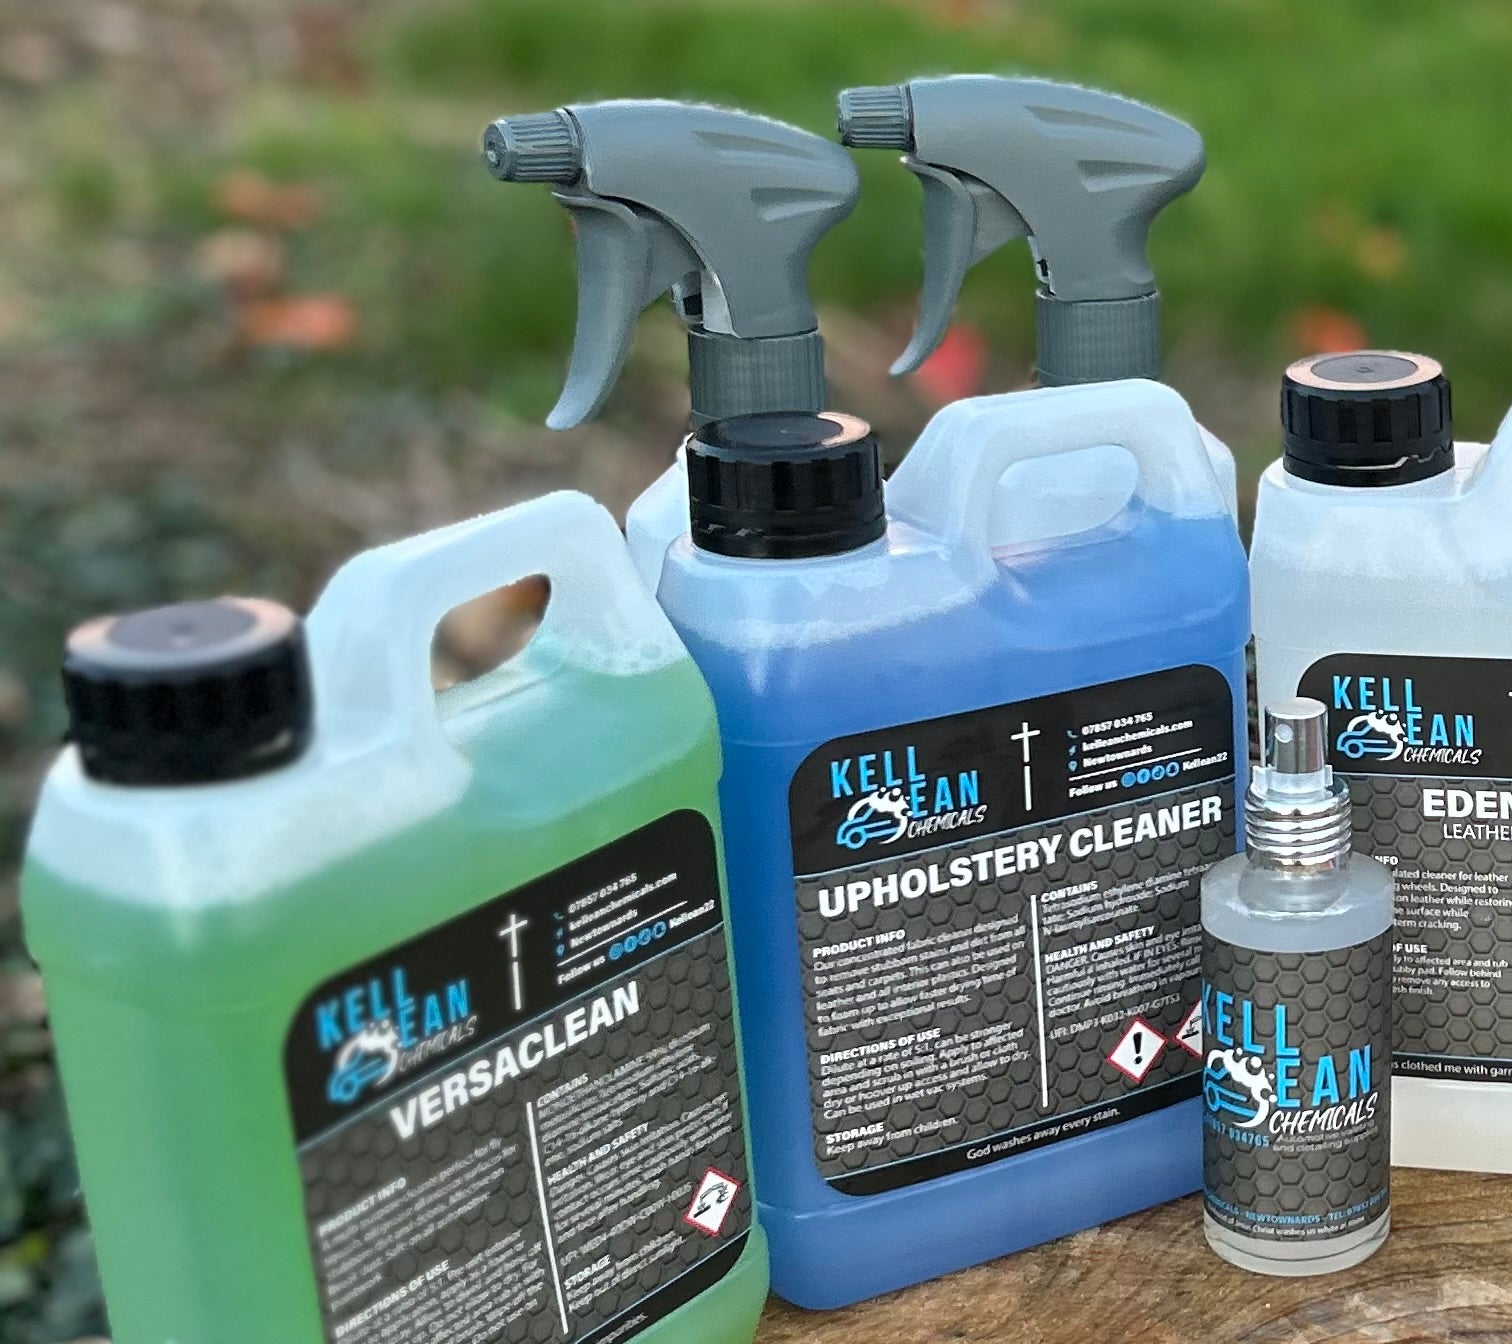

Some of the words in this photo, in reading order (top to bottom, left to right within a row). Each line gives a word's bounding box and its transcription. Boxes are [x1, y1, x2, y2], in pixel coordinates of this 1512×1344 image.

[1334, 676, 1421, 712] KELL
[832, 746, 925, 798] KELL
[1404, 747, 1482, 764] CHEMICALS
[1070, 784, 1103, 797] Follow
[1105, 780, 1117, 789] us
[906, 805, 987, 838] CHEMICALS
[819, 834, 1062, 917] UPHOLSTERY
[1070, 796, 1221, 857] CLEANER
[1041, 881, 1098, 902] CONTAINS
[1422, 870, 1456, 880] cleaner
[1459, 871, 1472, 880] for
[1474, 872, 1508, 882] leather
[813, 936, 874, 958] PRODUCT
[876, 930, 905, 944] INFO
[1045, 944, 1087, 963] HEALTH
[1089, 938, 1112, 952] AND
[1114, 926, 1154, 944] SAFETY
[1405, 944, 1427, 953] USE
[318, 970, 414, 1048] KELL
[1202, 985, 1299, 1057] KELL
[390, 981, 639, 1138] VERSACLEAN
[820, 1040, 896, 1064] DIRECTIONS
[898, 1035, 915, 1046] OF
[917, 1028, 940, 1042] USE
[1401, 1060, 1441, 1072] clothed
[1444, 1061, 1461, 1074] me
[1464, 1065, 1488, 1074] with
[537, 1074, 588, 1107] CONTAINS
[1268, 1091, 1377, 1135] CHEMICALS
[826, 1122, 884, 1144] STORAGE
[967, 1144, 990, 1159] God
[992, 1134, 1032, 1152] washes
[1034, 1126, 1060, 1140] away
[1062, 1116, 1090, 1130] every
[1093, 1108, 1120, 1122] stain.
[547, 1157, 587, 1185] HEALTH
[588, 1144, 611, 1162] AND
[611, 1122, 648, 1149] SAFETY
[320, 1195, 376, 1236] PRODUCT
[378, 1178, 406, 1200] INFO
[1246, 1211, 1320, 1224] NEWTOWNARDS
[564, 1255, 610, 1289] STORAGE
[336, 1287, 407, 1337] DIRECTIONS
[409, 1275, 424, 1291] OF
[426, 1260, 449, 1280] USE
